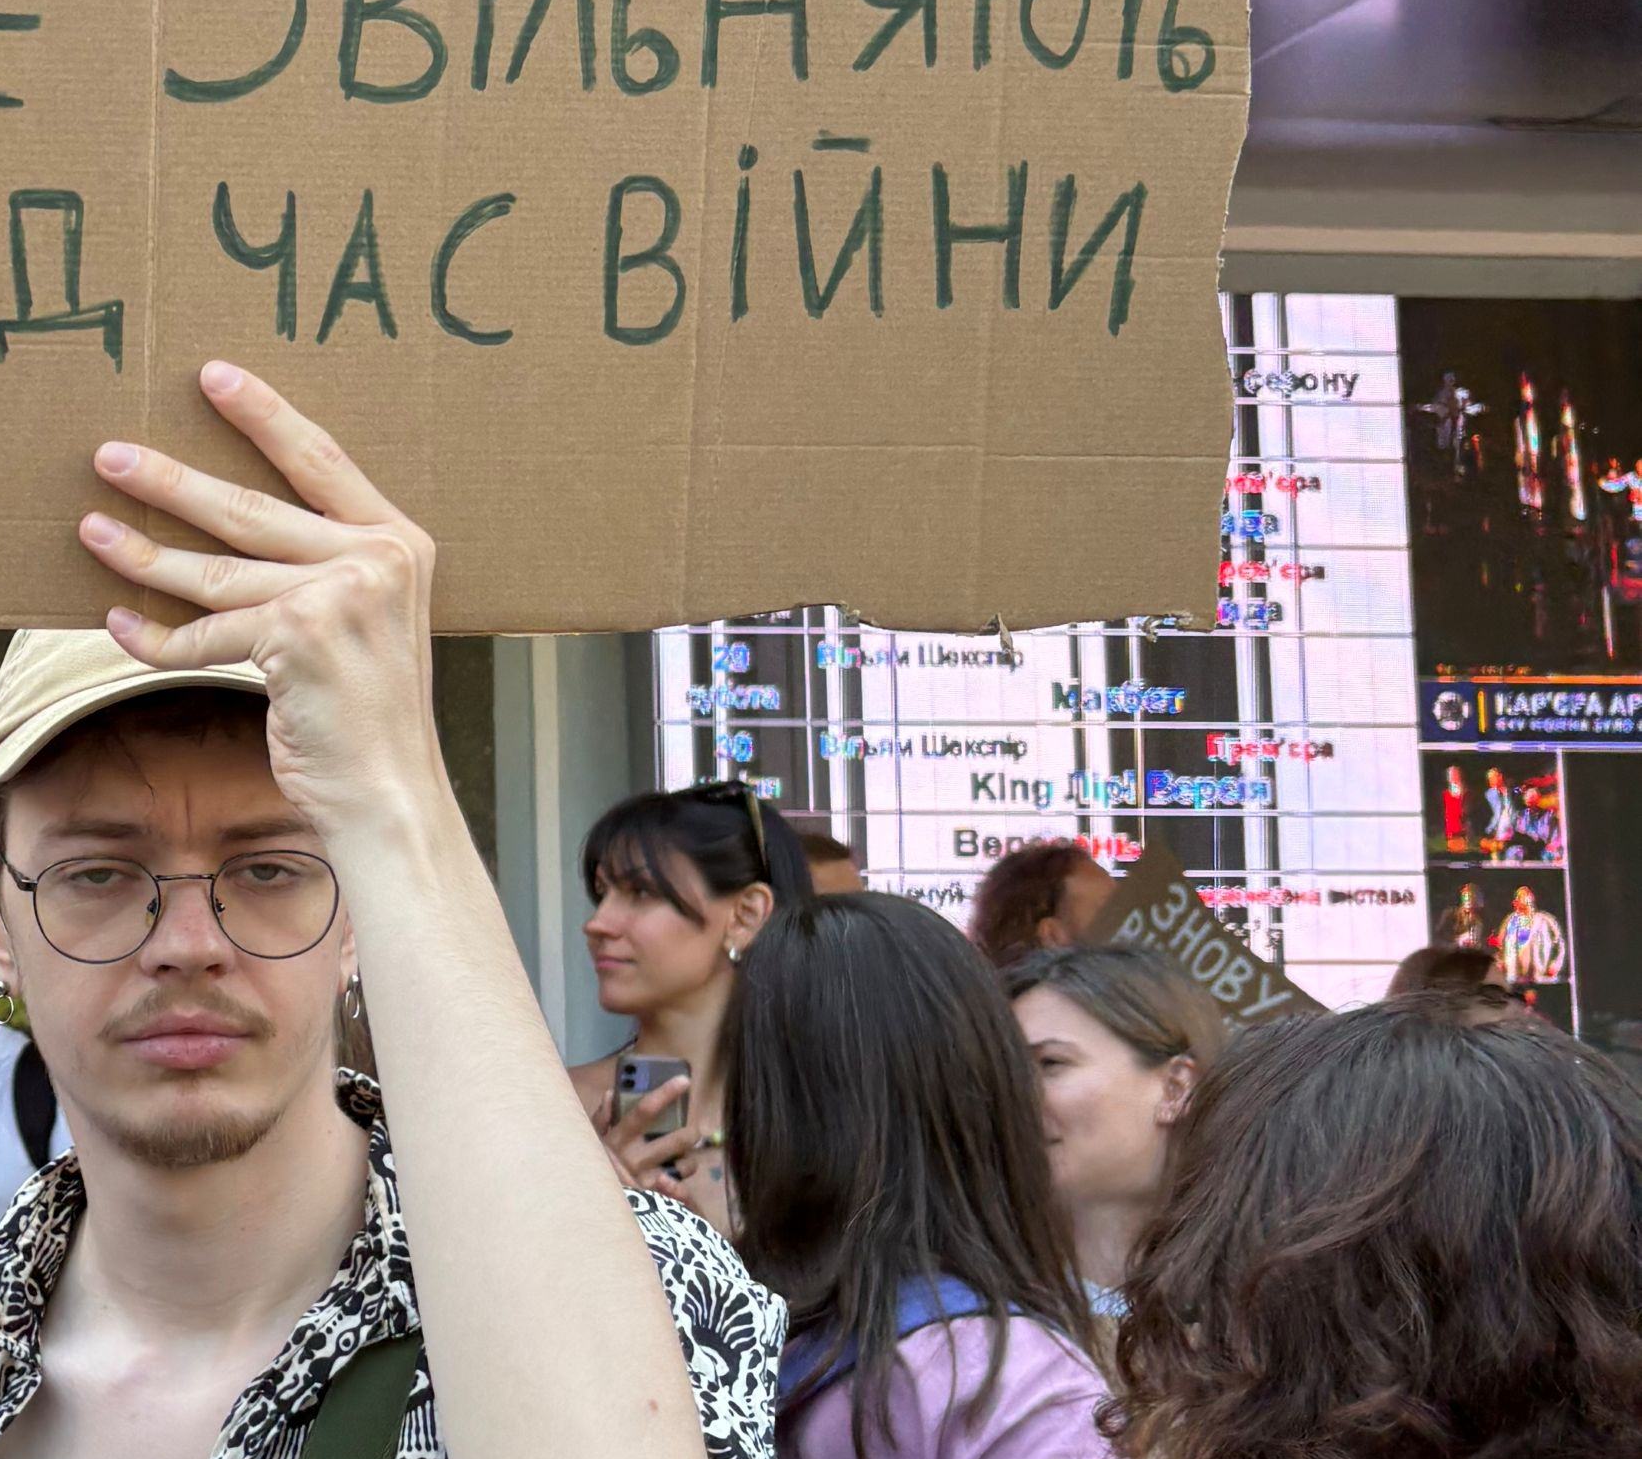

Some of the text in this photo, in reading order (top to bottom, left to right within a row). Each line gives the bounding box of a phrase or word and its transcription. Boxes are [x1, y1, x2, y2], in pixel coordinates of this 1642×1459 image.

[211, 179, 517, 347] ЧАС
[602, 132, 1149, 347] ВІЙНИ
[1150, 881, 1294, 1018] ЗНОВУ
